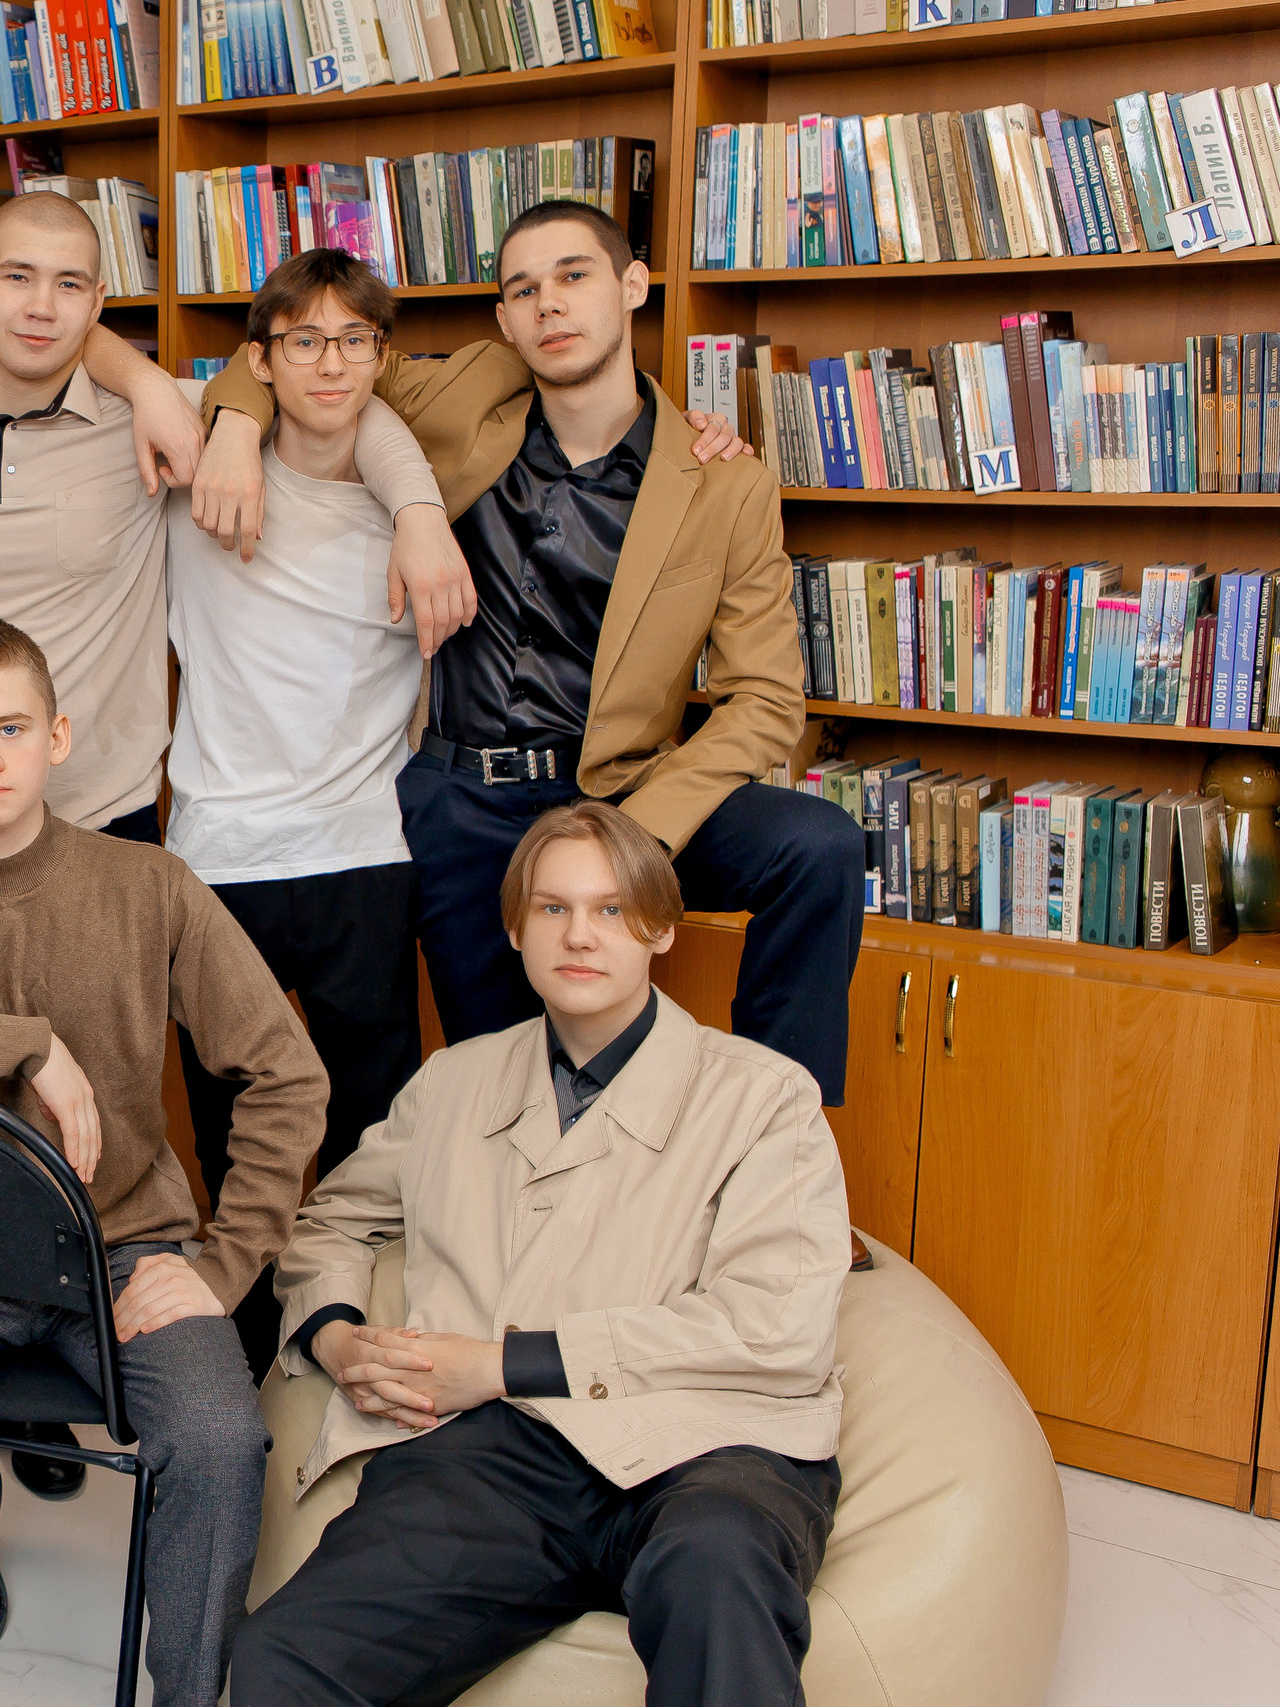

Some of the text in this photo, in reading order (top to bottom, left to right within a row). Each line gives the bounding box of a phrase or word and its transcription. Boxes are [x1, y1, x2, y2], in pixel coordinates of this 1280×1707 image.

[332, 0, 357, 63] Вампило
[309, 54, 339, 91] В
[1192, 114, 1216, 138] Б.
[1068, 136, 1096, 235] Валентин Курбатов
[1082, 134, 1112, 233] Валентин Курбатов
[1202, 142, 1236, 211] Лапин
[1181, 203, 1222, 249] Л
[694, 350, 704, 388] БЕЗДНА
[720, 353, 730, 391] БЕЗДНА
[974, 450, 1016, 488] М
[1260, 582, 1270, 618] СТОРОНА
[1256, 619, 1268, 667] ПОСОЛЬСКАЯ
[1214, 672, 1228, 719] ЛЕДОГОН
[1234, 672, 1248, 719] ЛЕДОГОН
[888, 800, 899, 830] ГАРЬ
[1066, 845, 1075, 881] ЖИЗНИ
[918, 874, 926, 900] ЕФИМ
[940, 877, 949, 903] ЕФИМ
[962, 881, 971, 906] ЕФИМ
[1063, 901, 1072, 937] ШАГАЯ
[1149, 880, 1165, 942] ПОВЕСТИ
[1192, 882, 1209, 947] ПОВЕСТИ
